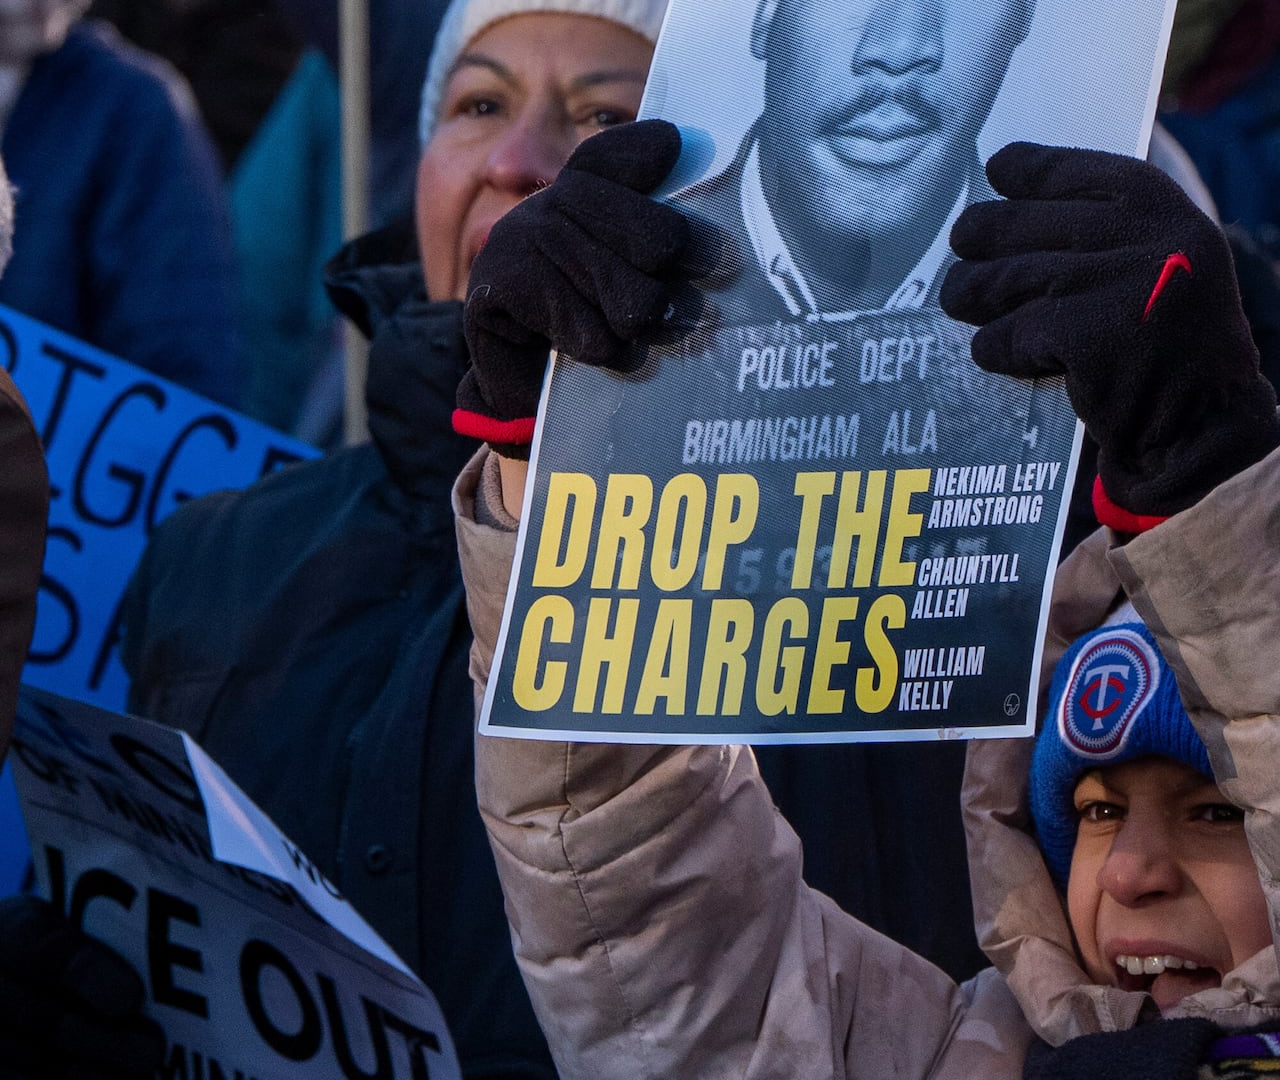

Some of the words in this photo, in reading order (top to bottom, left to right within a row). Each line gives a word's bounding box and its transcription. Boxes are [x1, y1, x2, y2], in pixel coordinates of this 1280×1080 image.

[737, 341, 839, 392] POLICE
[859, 335, 935, 383] DEPT
[682, 412, 860, 464] BIRMINGHAM
[881, 409, 938, 456] ALA
[933, 465, 1007, 496] NEKIMA
[1012, 462, 1061, 493] LEVY
[928, 495, 1044, 529] ARMSTRONG
[532, 473, 759, 592] DROP
[790, 468, 931, 590] THE
[918, 554, 1020, 587] CHAUNTYLL
[911, 588, 970, 620] ALLEN
[513, 594, 906, 717] CHARGES
[904, 646, 986, 678] WILLIAM
[898, 681, 954, 712] KELLY
